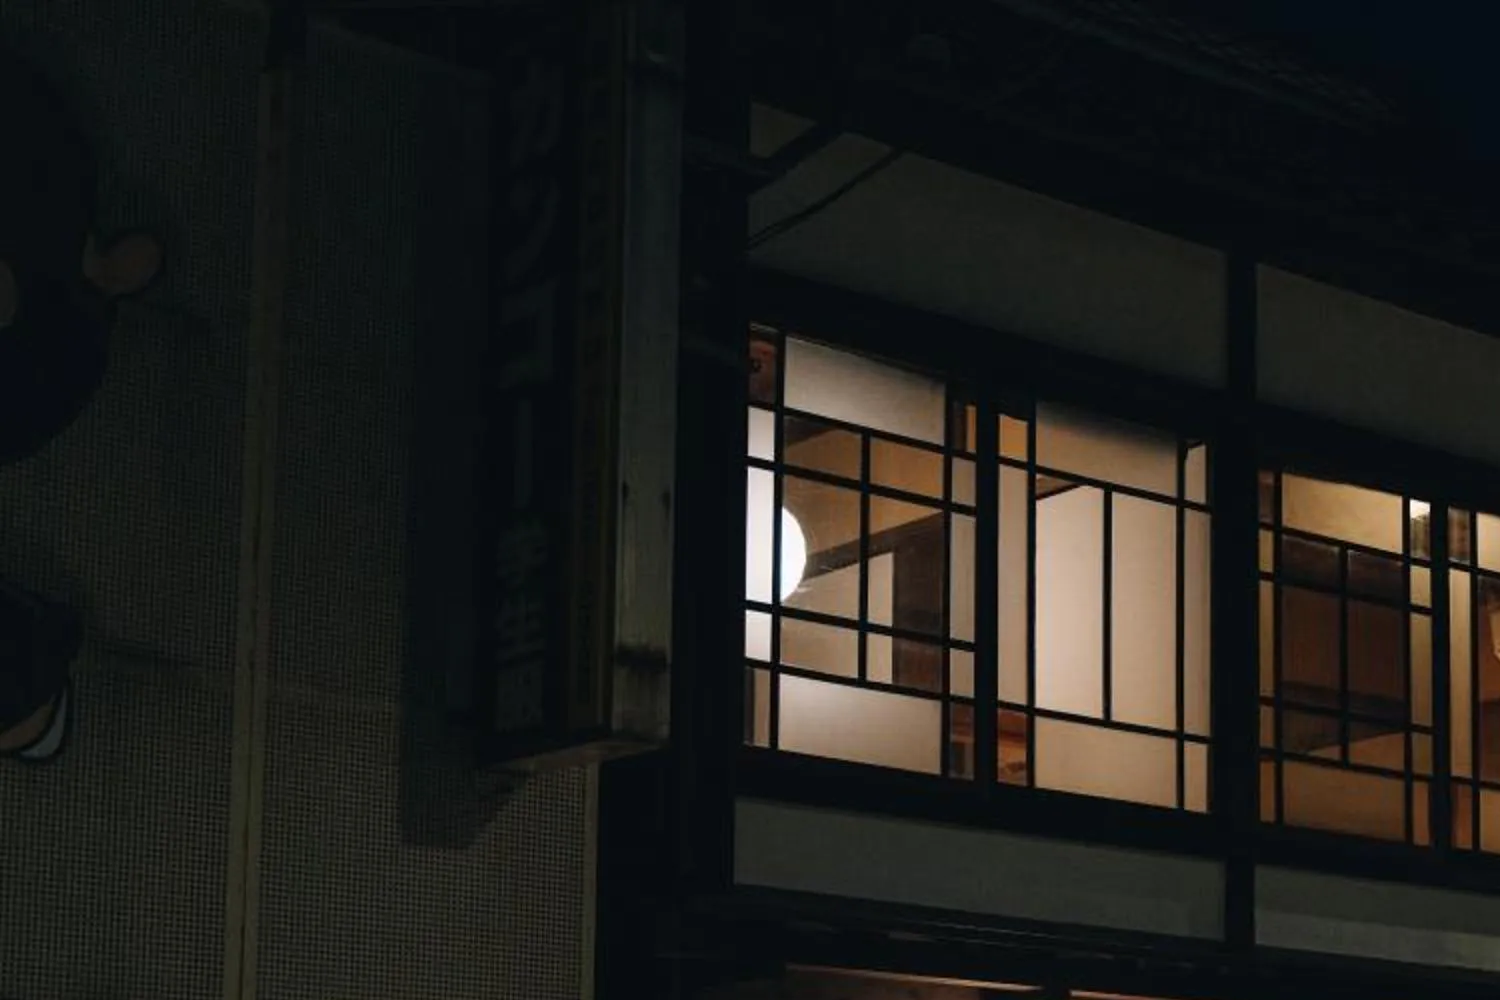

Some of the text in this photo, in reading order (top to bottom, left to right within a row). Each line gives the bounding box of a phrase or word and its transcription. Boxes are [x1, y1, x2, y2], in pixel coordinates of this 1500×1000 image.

[496, 57, 564, 732] カンコー学生服
